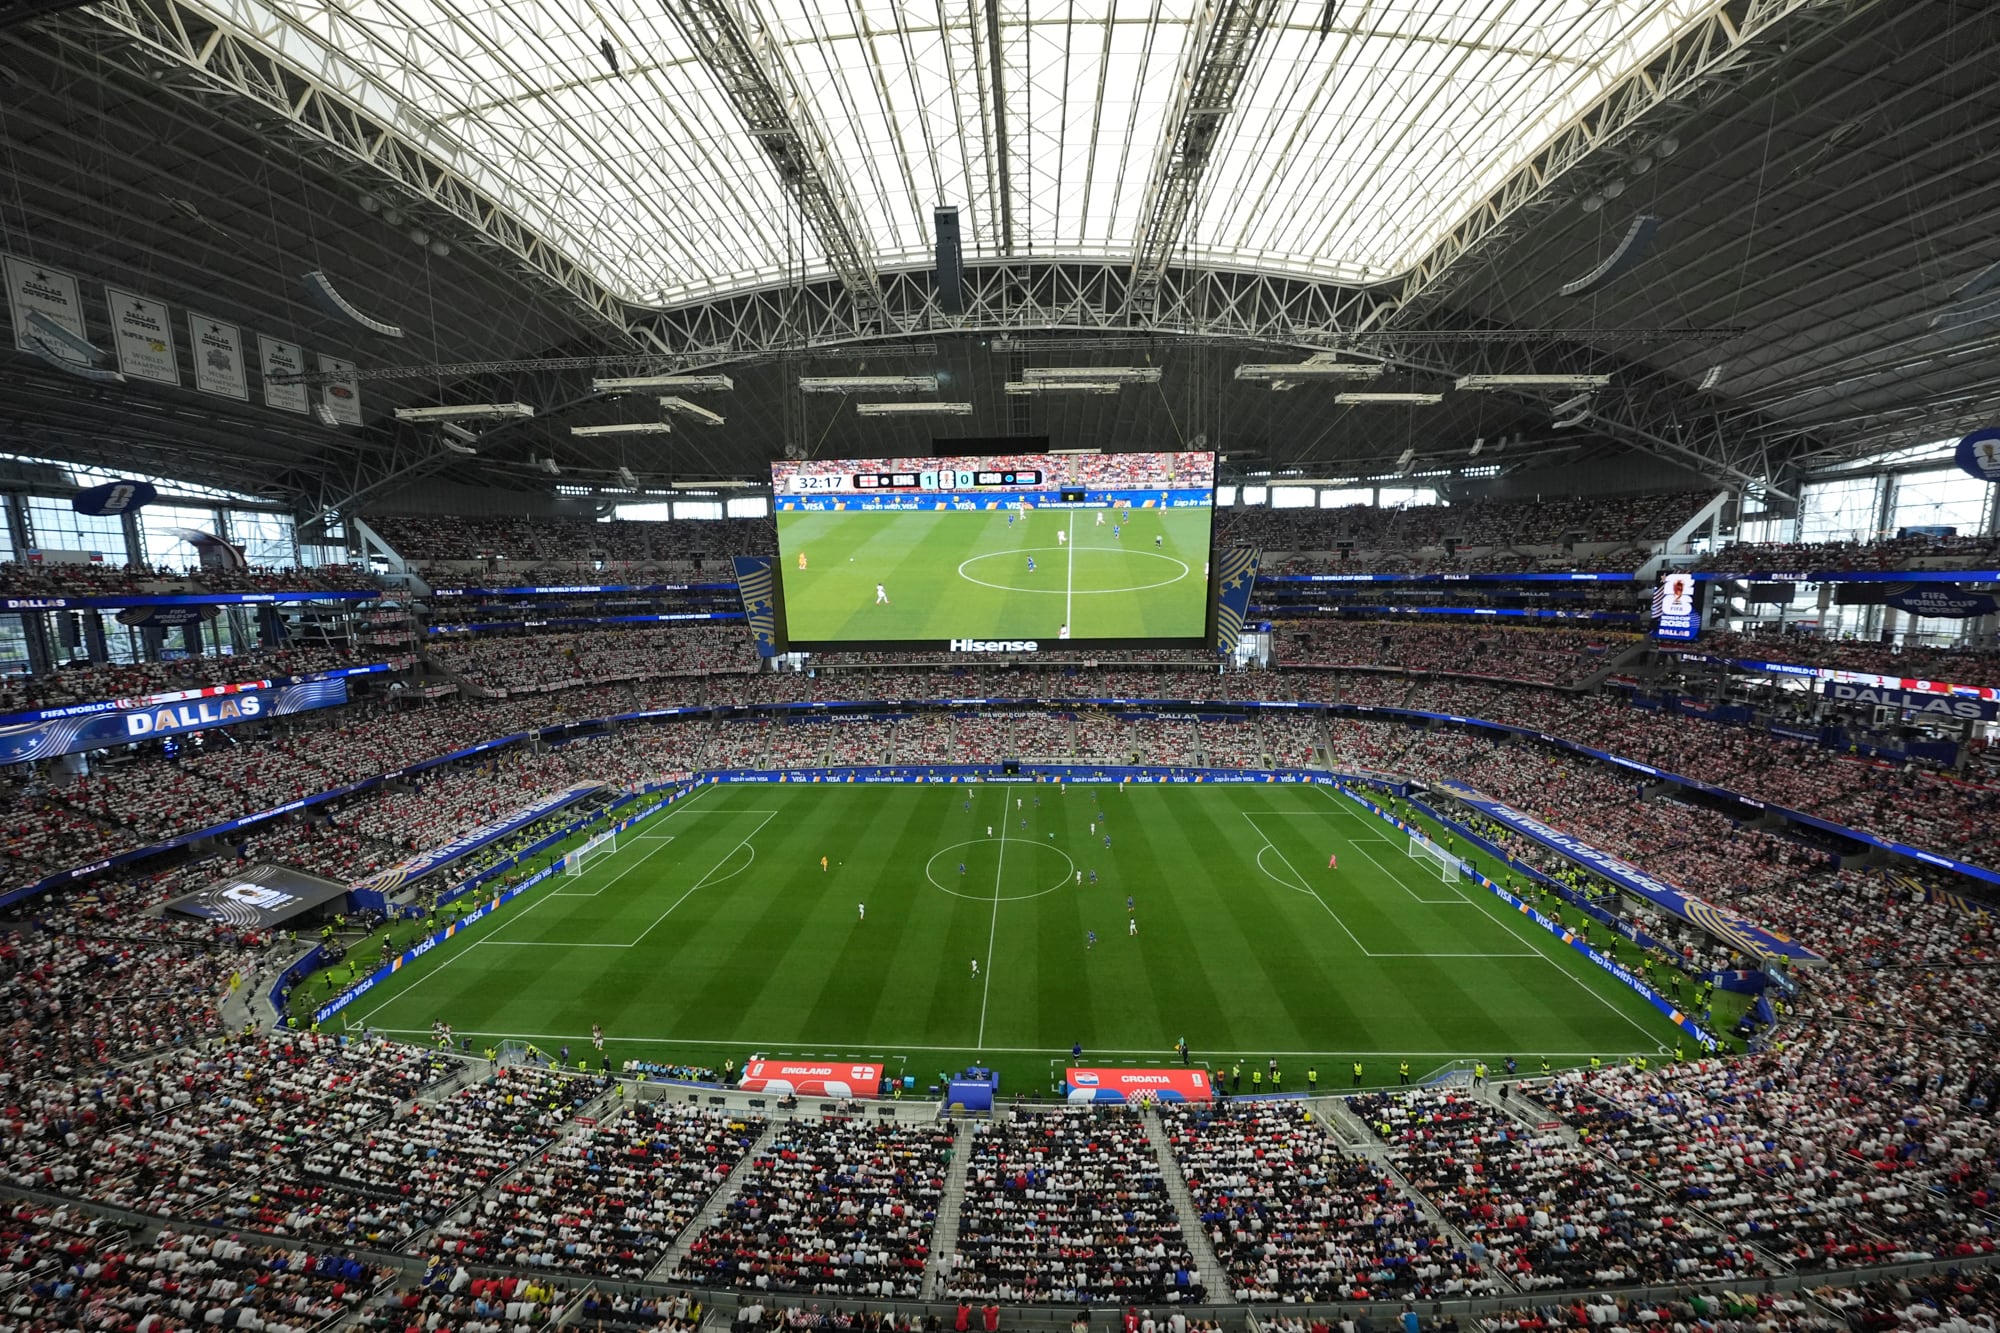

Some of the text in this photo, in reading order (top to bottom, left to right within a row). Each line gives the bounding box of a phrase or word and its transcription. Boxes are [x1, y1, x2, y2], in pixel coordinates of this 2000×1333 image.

[25, 280, 62, 297] DALLAS
[22, 287, 68, 306] COWBOYS
[126, 310, 156, 324] DALLAS
[122, 317, 160, 332] COWBOYS
[201, 338, 233, 352] COWBOYS
[203, 333, 229, 345] DALLAS
[131, 352, 164, 364] WORLD
[268, 358, 296, 370] COWBOYS
[271, 353, 292, 362] DALLAS
[123, 356, 174, 374] CHAMPIONS
[200, 375, 243, 390] CHAMPIONS
[208, 370, 234, 382] WORLD
[800, 476, 842, 489] 32:17
[892, 476, 915, 486] ENG
[926, 476, 932, 486] 1
[960, 474, 968, 484] 0
[978, 473, 1001, 484] CRO
[802, 502, 825, 510] VISA
[862, 503, 874, 511] tap
[954, 502, 976, 510] VISA
[8, 599, 66, 608] DALLAS
[1903, 599, 1949, 607] WORLD
[1659, 628, 1690, 637] DALLAS
[950, 639, 1038, 652] Hisense
[1782, 666, 1808, 674] WORLD
[1834, 685, 1982, 719] DALLAS
[40, 704, 105, 719] FIFA WORLD
[126, 696, 260, 736] DALLAS
[458, 822, 510, 852] WORLD
[507, 810, 532, 824] CUP
[1491, 806, 1666, 893] FIFA WORLD CUP 2026
[71, 860, 110, 878] DALLAS
[530, 874, 542, 886] with
[453, 885, 466, 896] FIFA
[1496, 886, 1512, 904] VISA
[462, 910, 483, 926] VISA
[1535, 912, 1554, 932] VISA
[1618, 922, 1633, 935] FIFA
[412, 938, 436, 958] VISA
[1589, 950, 1652, 1000] tap in with VISA
[320, 978, 374, 1021] in with VISA
[781, 1066, 832, 1075] ENGLAND
[1121, 1075, 1170, 1084] CROATIA
